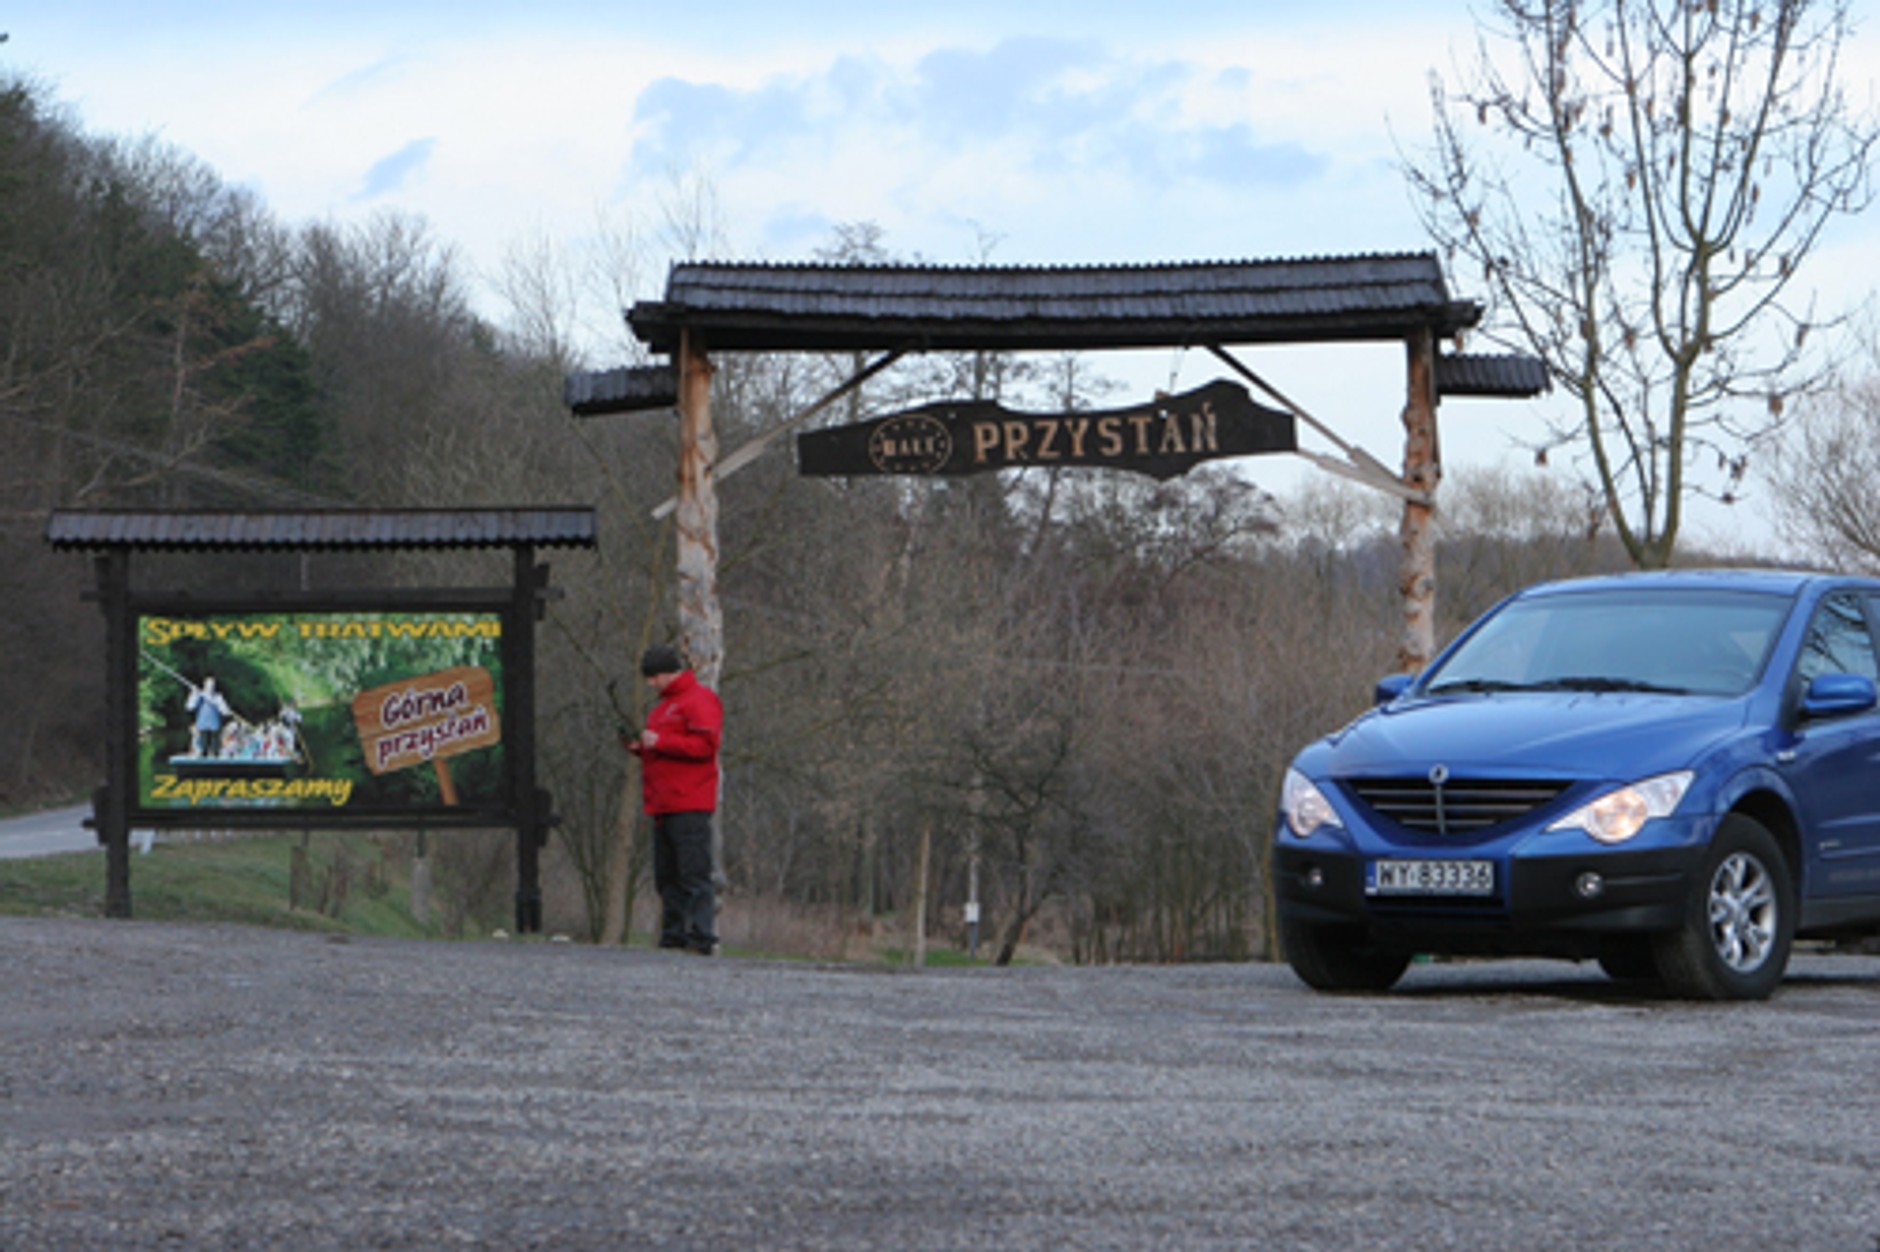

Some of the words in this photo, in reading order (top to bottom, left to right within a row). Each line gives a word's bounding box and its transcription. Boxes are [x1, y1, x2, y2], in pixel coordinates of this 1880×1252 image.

[973, 401, 1220, 463] PRZYSTAŃ
[382, 682, 467, 728] Górna
[150, 774, 353, 806] Zapraszamy
